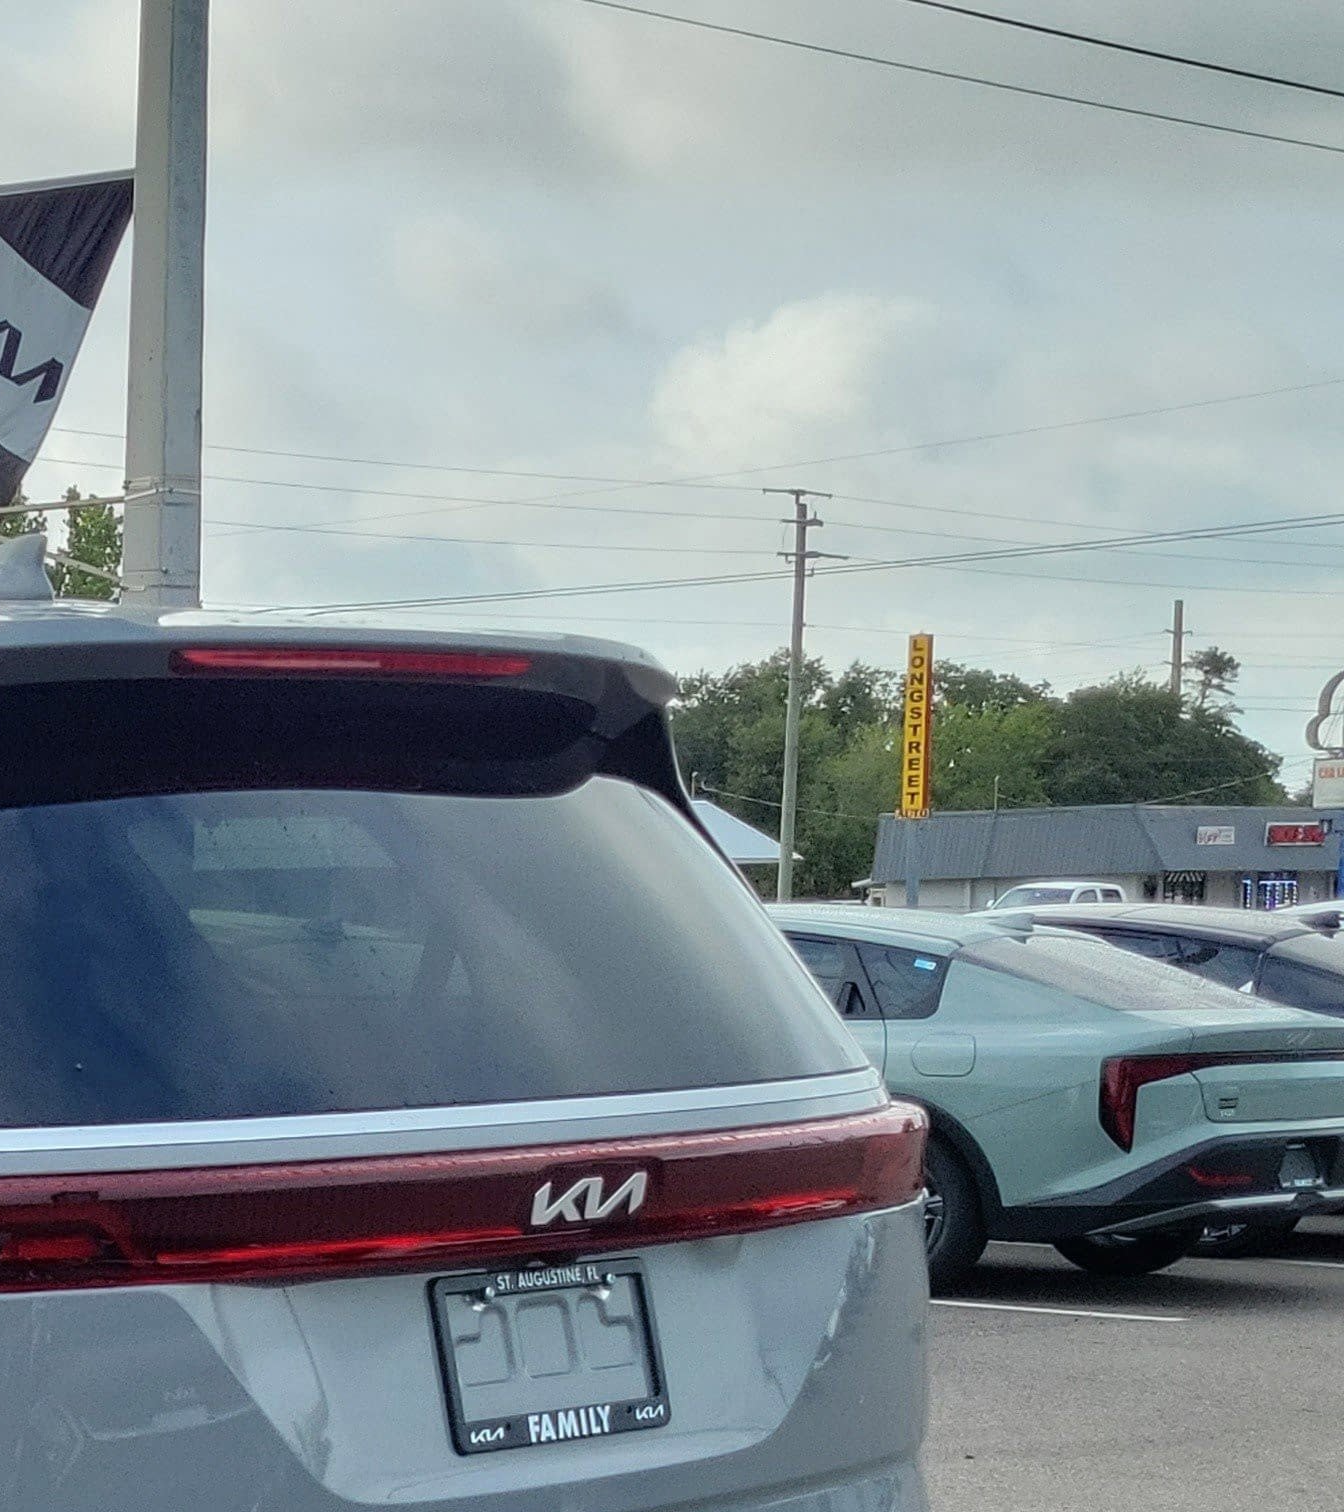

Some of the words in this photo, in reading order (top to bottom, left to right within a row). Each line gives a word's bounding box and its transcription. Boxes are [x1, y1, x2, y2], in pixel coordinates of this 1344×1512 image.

[905, 638, 925, 805] LONGSTREET
[530, 1171, 648, 1226] KIA
[497, 1275, 514, 1291] ST.
[518, 1267, 585, 1290] AUGUSTINE,
[586, 1265, 600, 1281] FL
[470, 1427, 505, 1443] KIA
[528, 1405, 611, 1443] FAMILY
